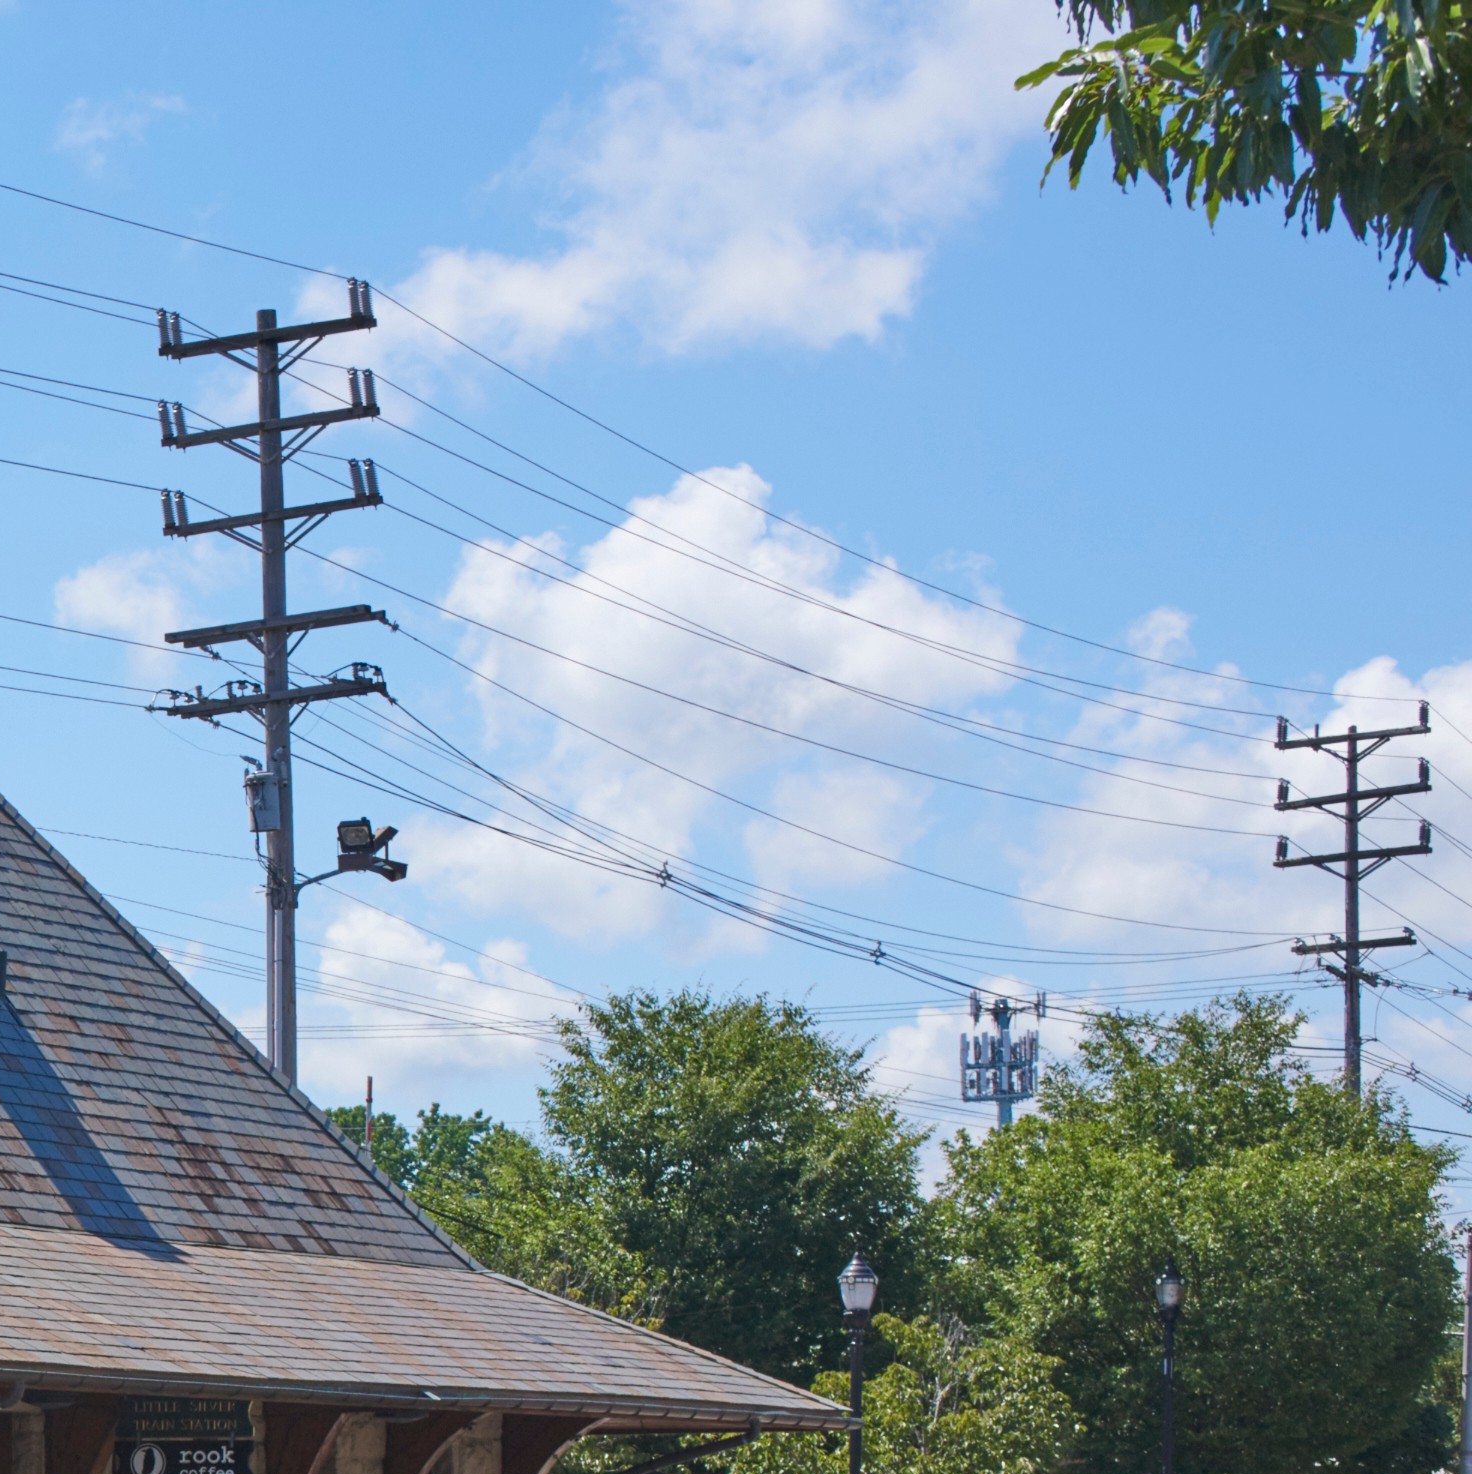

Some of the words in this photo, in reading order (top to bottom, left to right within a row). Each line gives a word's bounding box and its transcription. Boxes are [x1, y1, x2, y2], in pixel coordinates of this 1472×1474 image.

[135, 1401, 180, 1413] LITTLE
[190, 1401, 235, 1412] SILVER
[135, 1420, 175, 1431] TRAIN
[181, 1419, 237, 1431] STATION
[179, 1446, 235, 1464] rook
